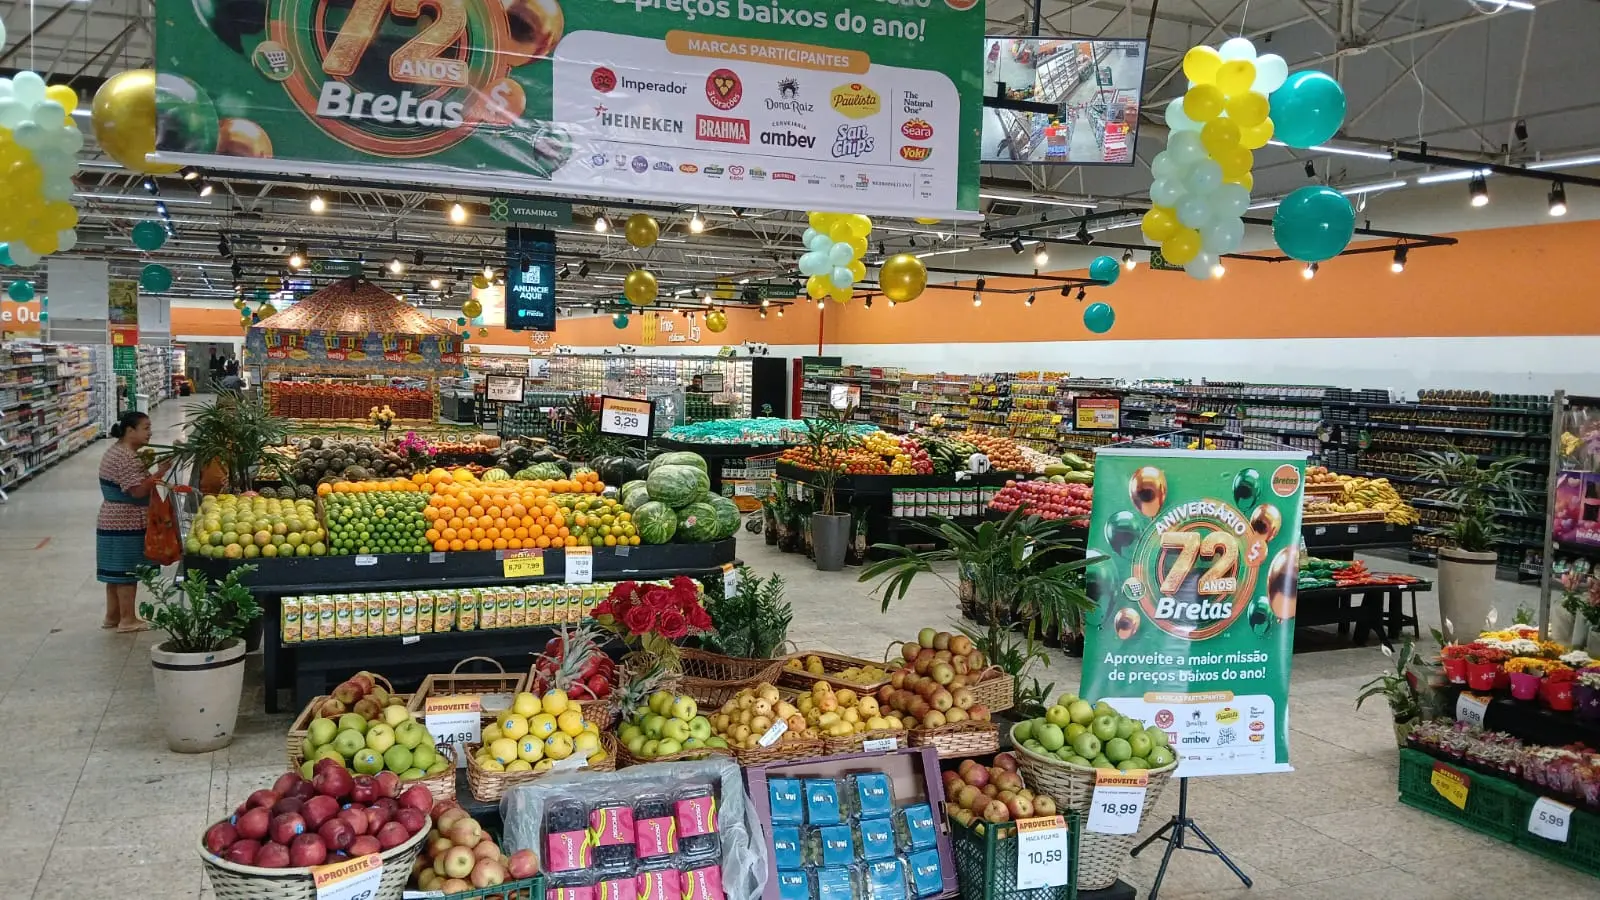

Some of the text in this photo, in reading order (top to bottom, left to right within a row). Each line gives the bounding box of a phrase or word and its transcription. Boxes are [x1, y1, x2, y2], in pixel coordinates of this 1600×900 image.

[635, 0, 926, 42] preços baixos do ano!
[687, 39, 850, 67] MARCAS PARTICIPANTES
[399, 60, 464, 82] ANOS
[621, 76, 688, 94] Imperador
[833, 94, 876, 108] Paulista
[903, 90, 919, 99] The
[315, 81, 467, 129] Bretas
[903, 99, 933, 108] Natural
[601, 113, 684, 134] HEINEKEN
[699, 119, 747, 141] BRAHMA
[902, 125, 931, 137] Seara
[759, 130, 817, 149] ambev
[902, 147, 926, 158] Yoki
[512, 207, 558, 217] VITAMINAS
[512, 284, 550, 293] ANUNCIE
[17, 306, 40, 324] Qu
[613, 415, 639, 428] 3,29
[1154, 501, 1247, 536] ANIVERSÁRIO
[1160, 531, 1239, 596] 72
[1202, 578, 1233, 592] ANOS
[1154, 597, 1233, 620] Bretas
[1103, 650, 1268, 667] Aproveite a maior missão
[1108, 667, 1266, 684] de preços baixos do ano!
[428, 703, 469, 712] APROVEITE
[1462, 707, 1481, 722] 8,99
[1181, 736, 1210, 744] ambev
[1097, 777, 1138, 785] APROVEITE
[1100, 803, 1138, 815] 18,99
[1019, 819, 1057, 830] APROVEITE
[1539, 811, 1564, 827] 5,99
[1027, 849, 1062, 865] 10,59
[317, 859, 369, 885] APROVEITE
